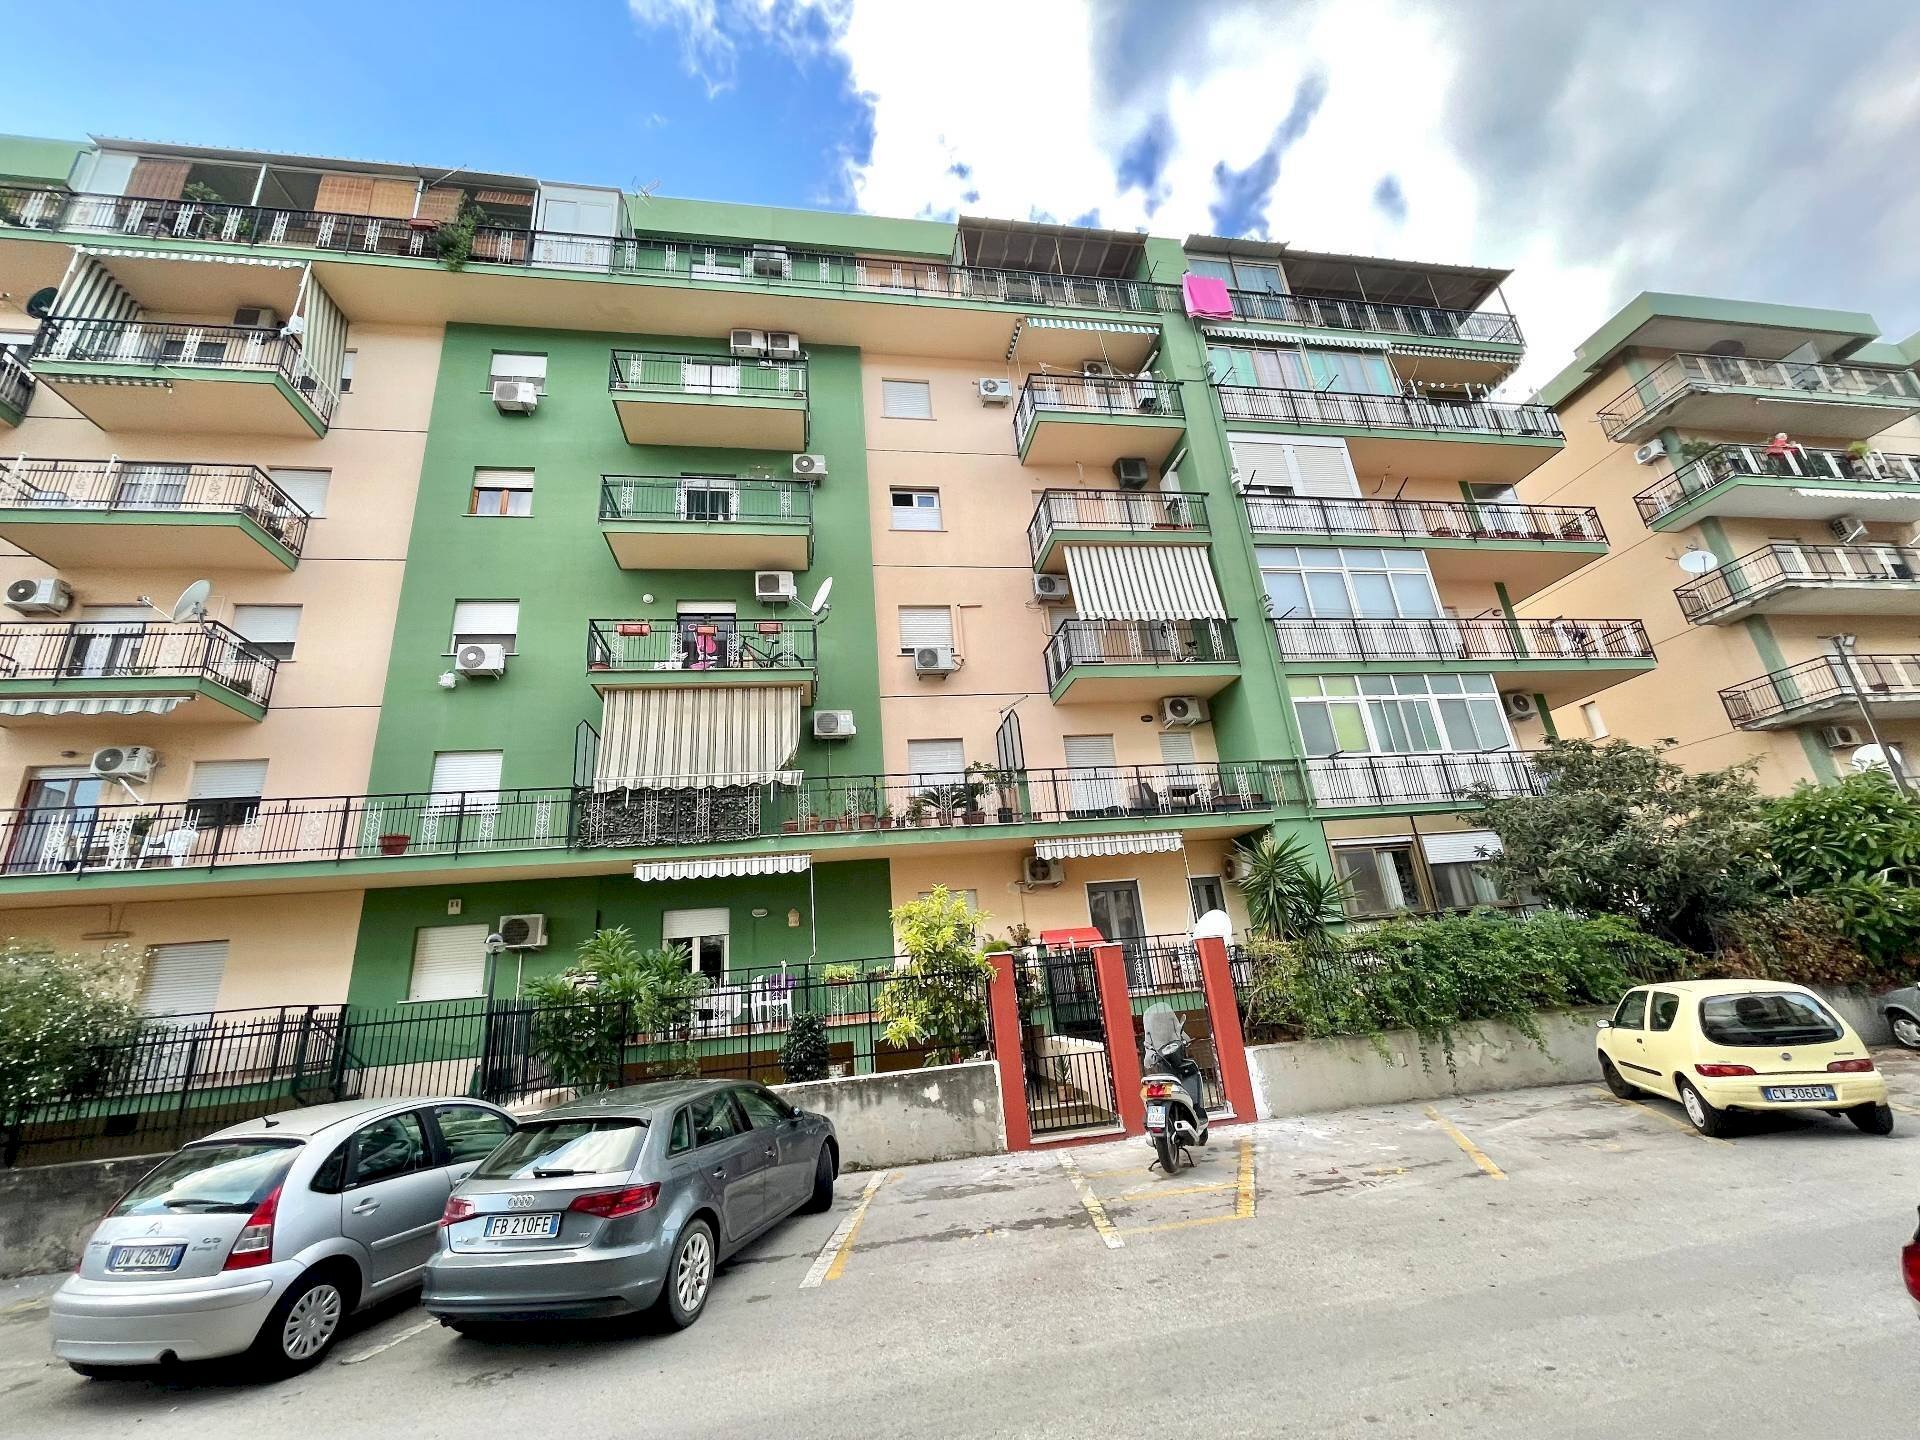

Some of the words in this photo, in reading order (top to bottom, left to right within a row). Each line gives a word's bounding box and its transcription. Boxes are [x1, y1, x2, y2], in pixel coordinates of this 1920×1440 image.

[1772, 1089, 1786, 1099] CV
[1790, 1087, 1827, 1099] 306EW
[492, 1218, 509, 1235] FB
[511, 1216, 551, 1234] 210FE
[117, 1249, 132, 1265] DW
[135, 1247, 173, 1265] 426MH
